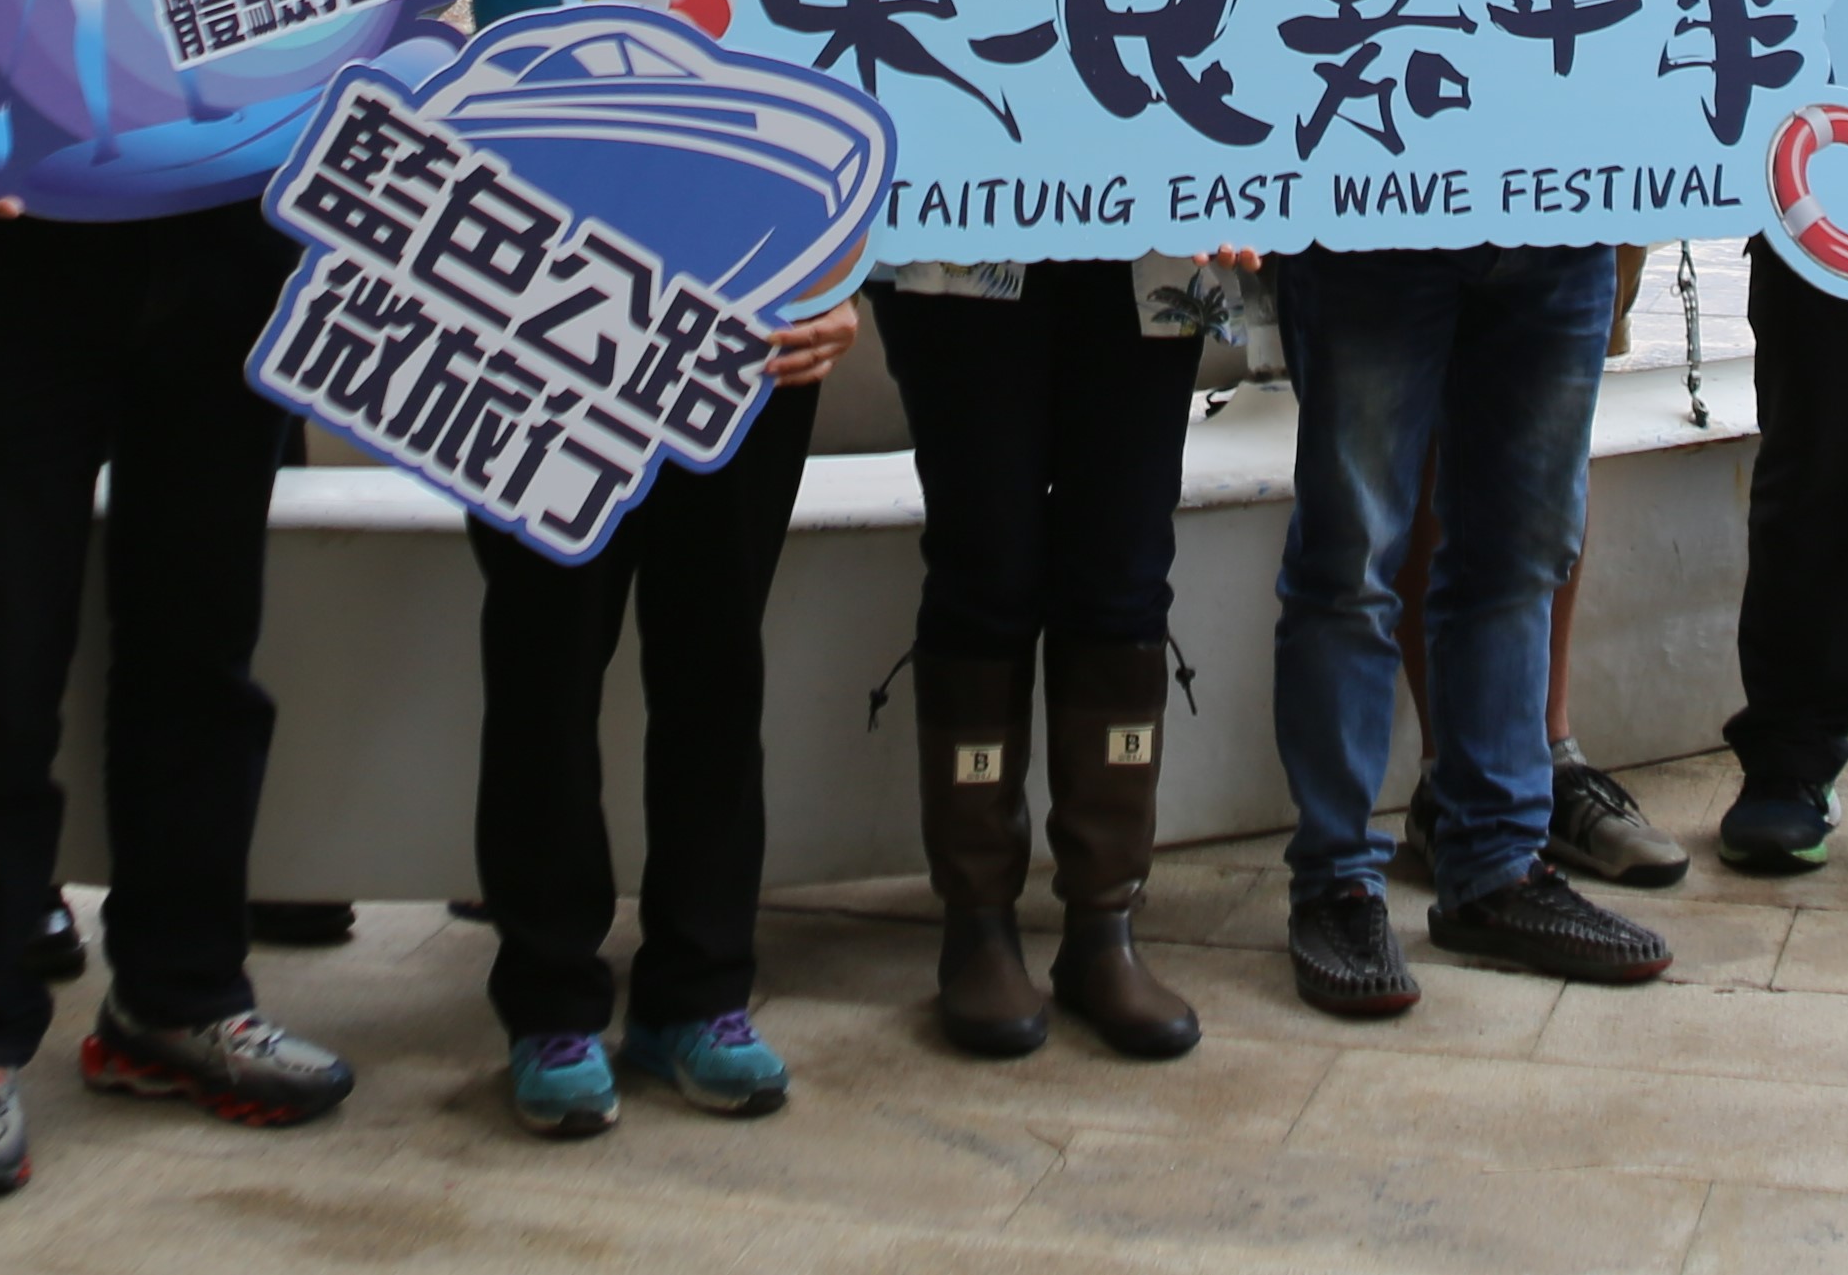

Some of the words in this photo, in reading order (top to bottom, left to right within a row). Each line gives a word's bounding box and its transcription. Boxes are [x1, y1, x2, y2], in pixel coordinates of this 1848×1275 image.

[292, 93, 779, 451] 藍色公路
[886, 175, 1136, 229] TAITUNG
[1168, 171, 1303, 222] EAST
[1333, 169, 1472, 217] WAVE
[1500, 163, 1743, 215] FESTIVAL
[273, 258, 634, 544] 微旅行
